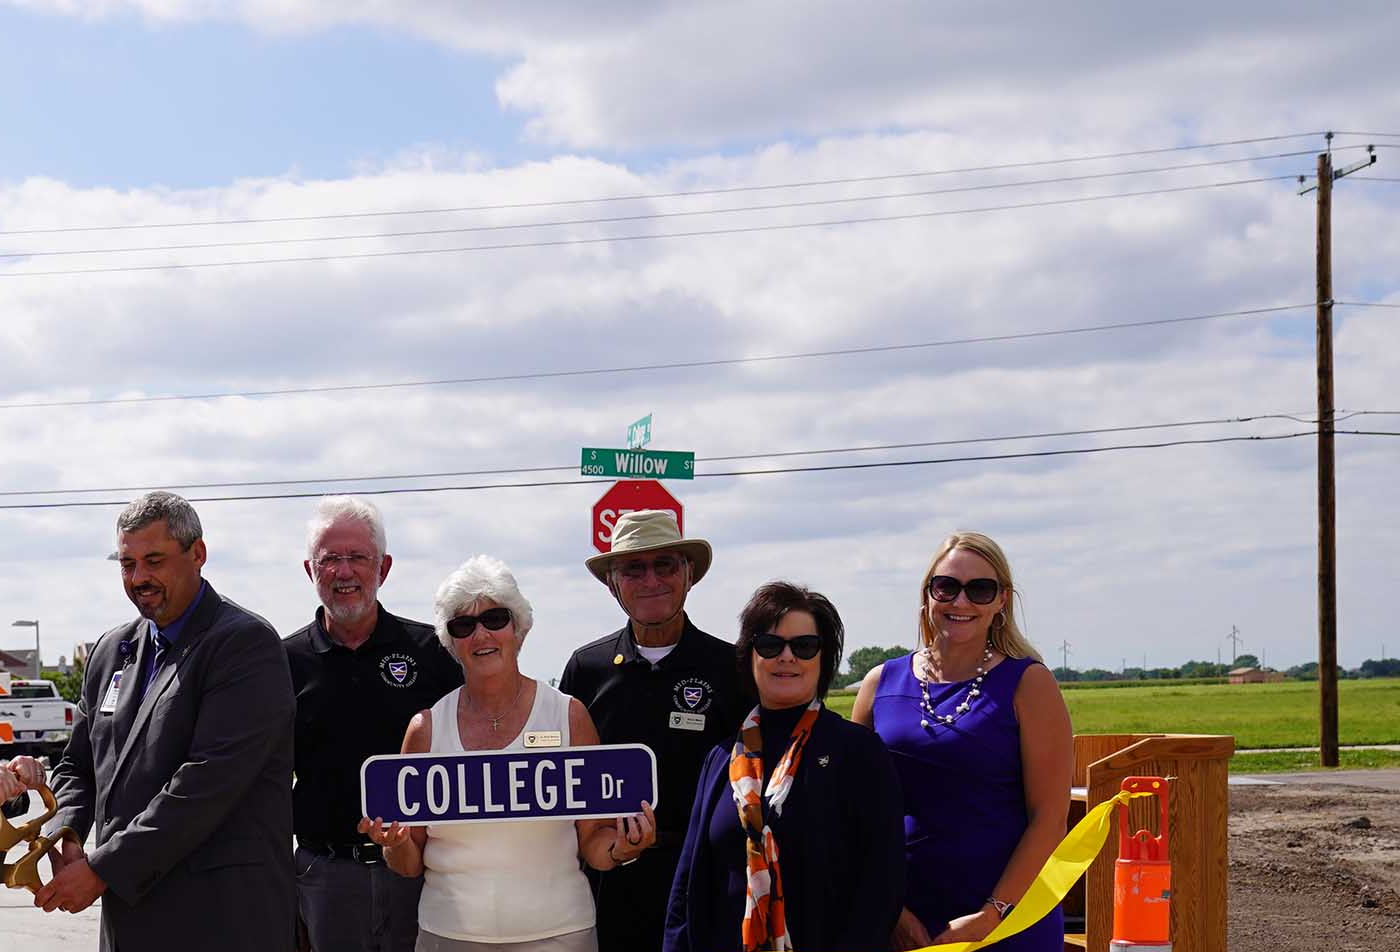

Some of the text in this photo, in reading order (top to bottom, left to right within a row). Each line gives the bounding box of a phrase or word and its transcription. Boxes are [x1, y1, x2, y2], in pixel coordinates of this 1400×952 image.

[582, 465, 604, 474] 4500
[591, 451, 597, 460] S
[615, 453, 668, 475] Willow
[397, 758, 624, 816] COLLEGE Dr
